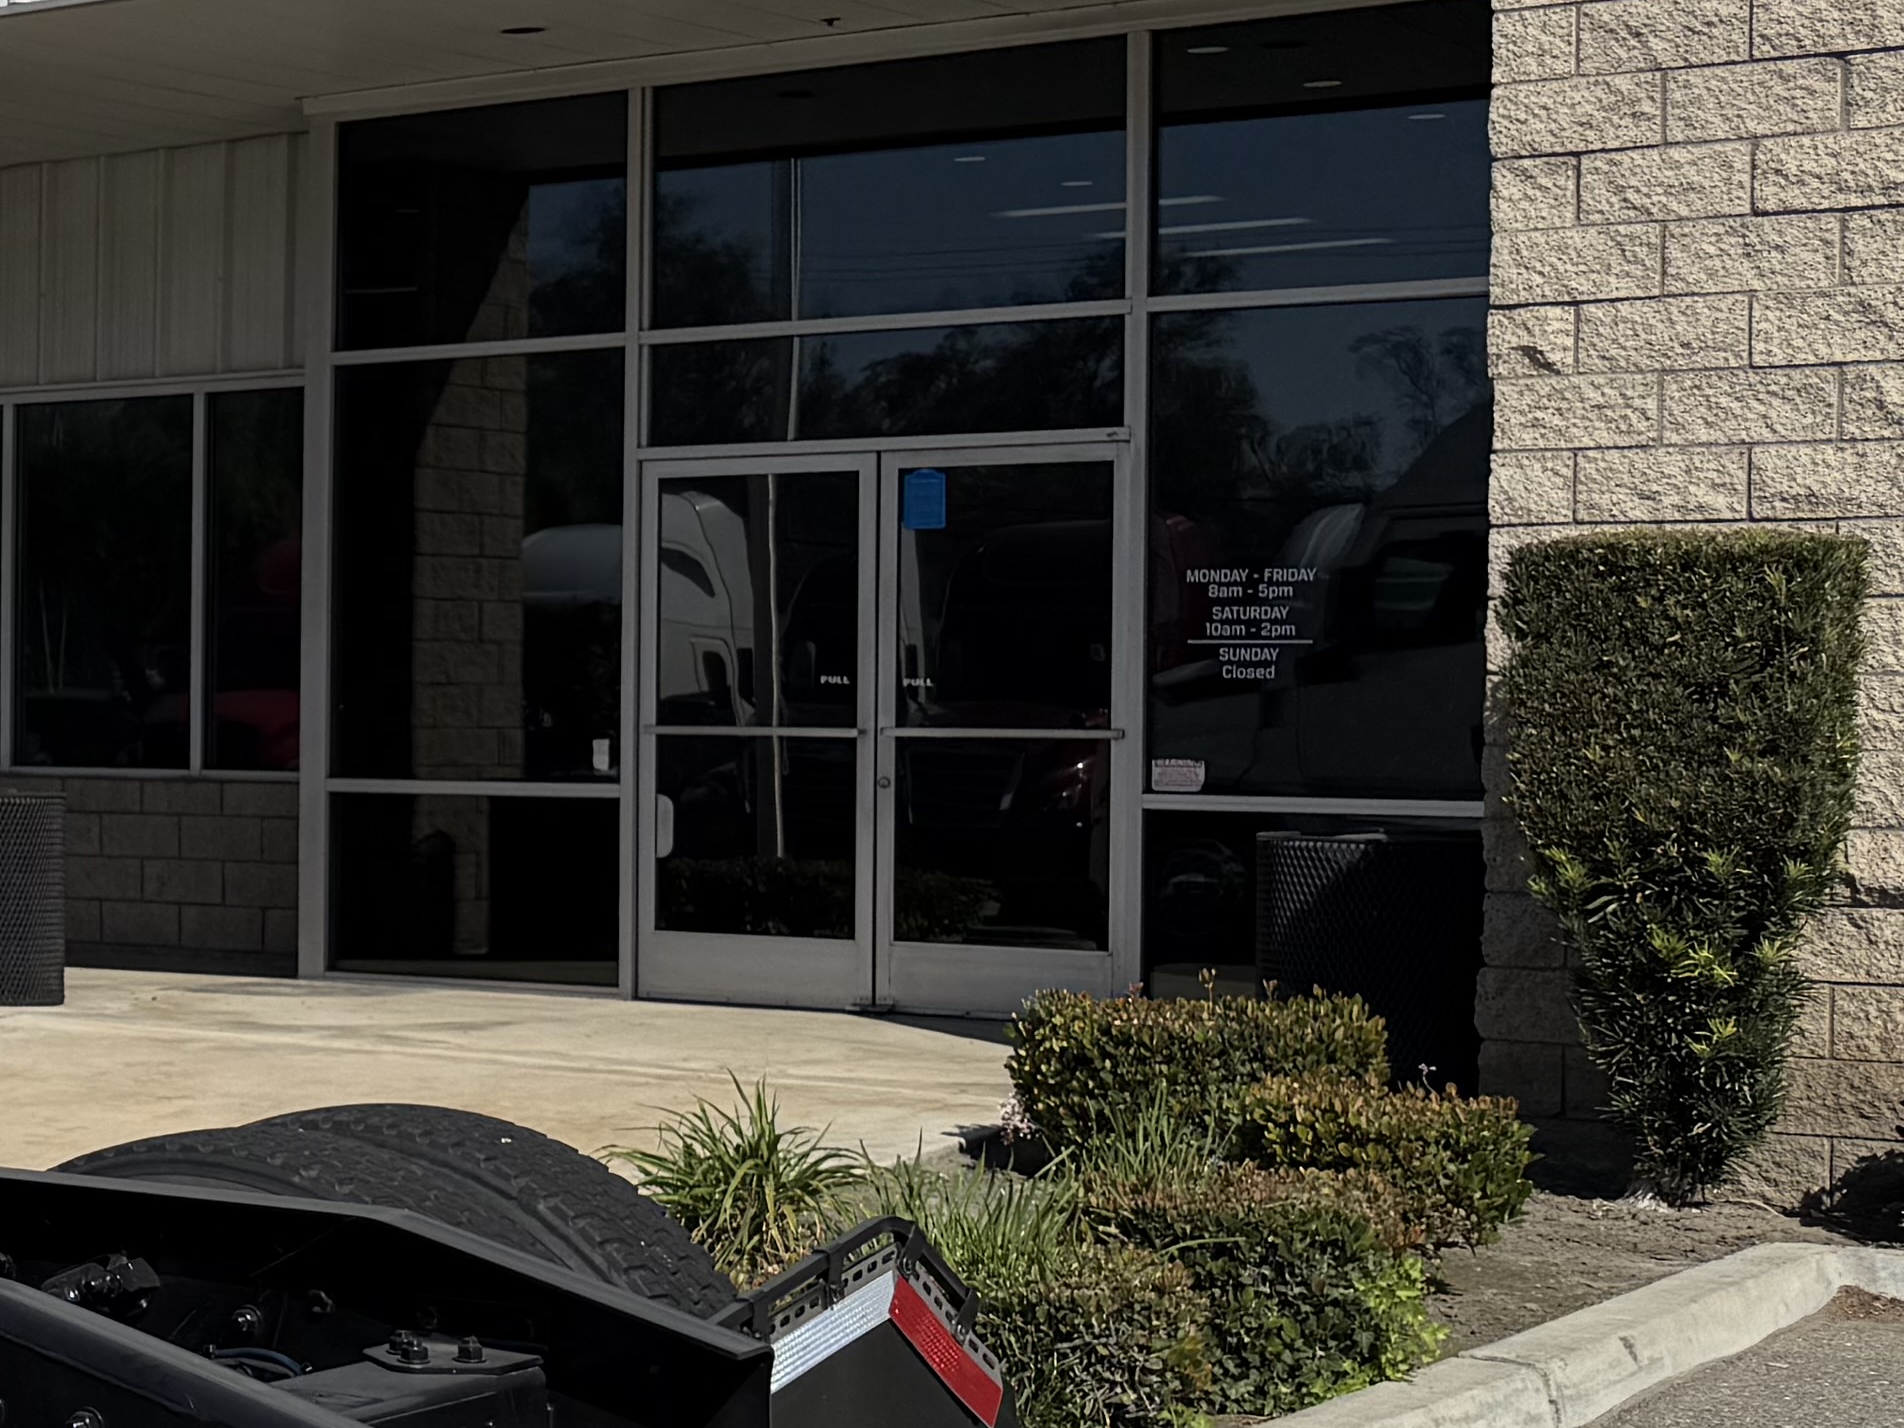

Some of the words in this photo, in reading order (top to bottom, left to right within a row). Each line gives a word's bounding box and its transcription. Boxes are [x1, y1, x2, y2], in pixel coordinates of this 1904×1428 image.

[1186, 568, 1249, 583] MONDAY
[1264, 568, 1317, 582] FRIDAY
[1208, 584, 1242, 598] 8am
[1258, 584, 1294, 600] 5pm
[1212, 606, 1290, 620] SATURDAY
[1205, 622, 1246, 636] 10am
[1260, 622, 1296, 637] 2pm
[1219, 647, 1280, 661] SUNDAY
[1222, 664, 1275, 679] Closed
[820, 675, 851, 685] PULL
[903, 678, 934, 687] PULL
